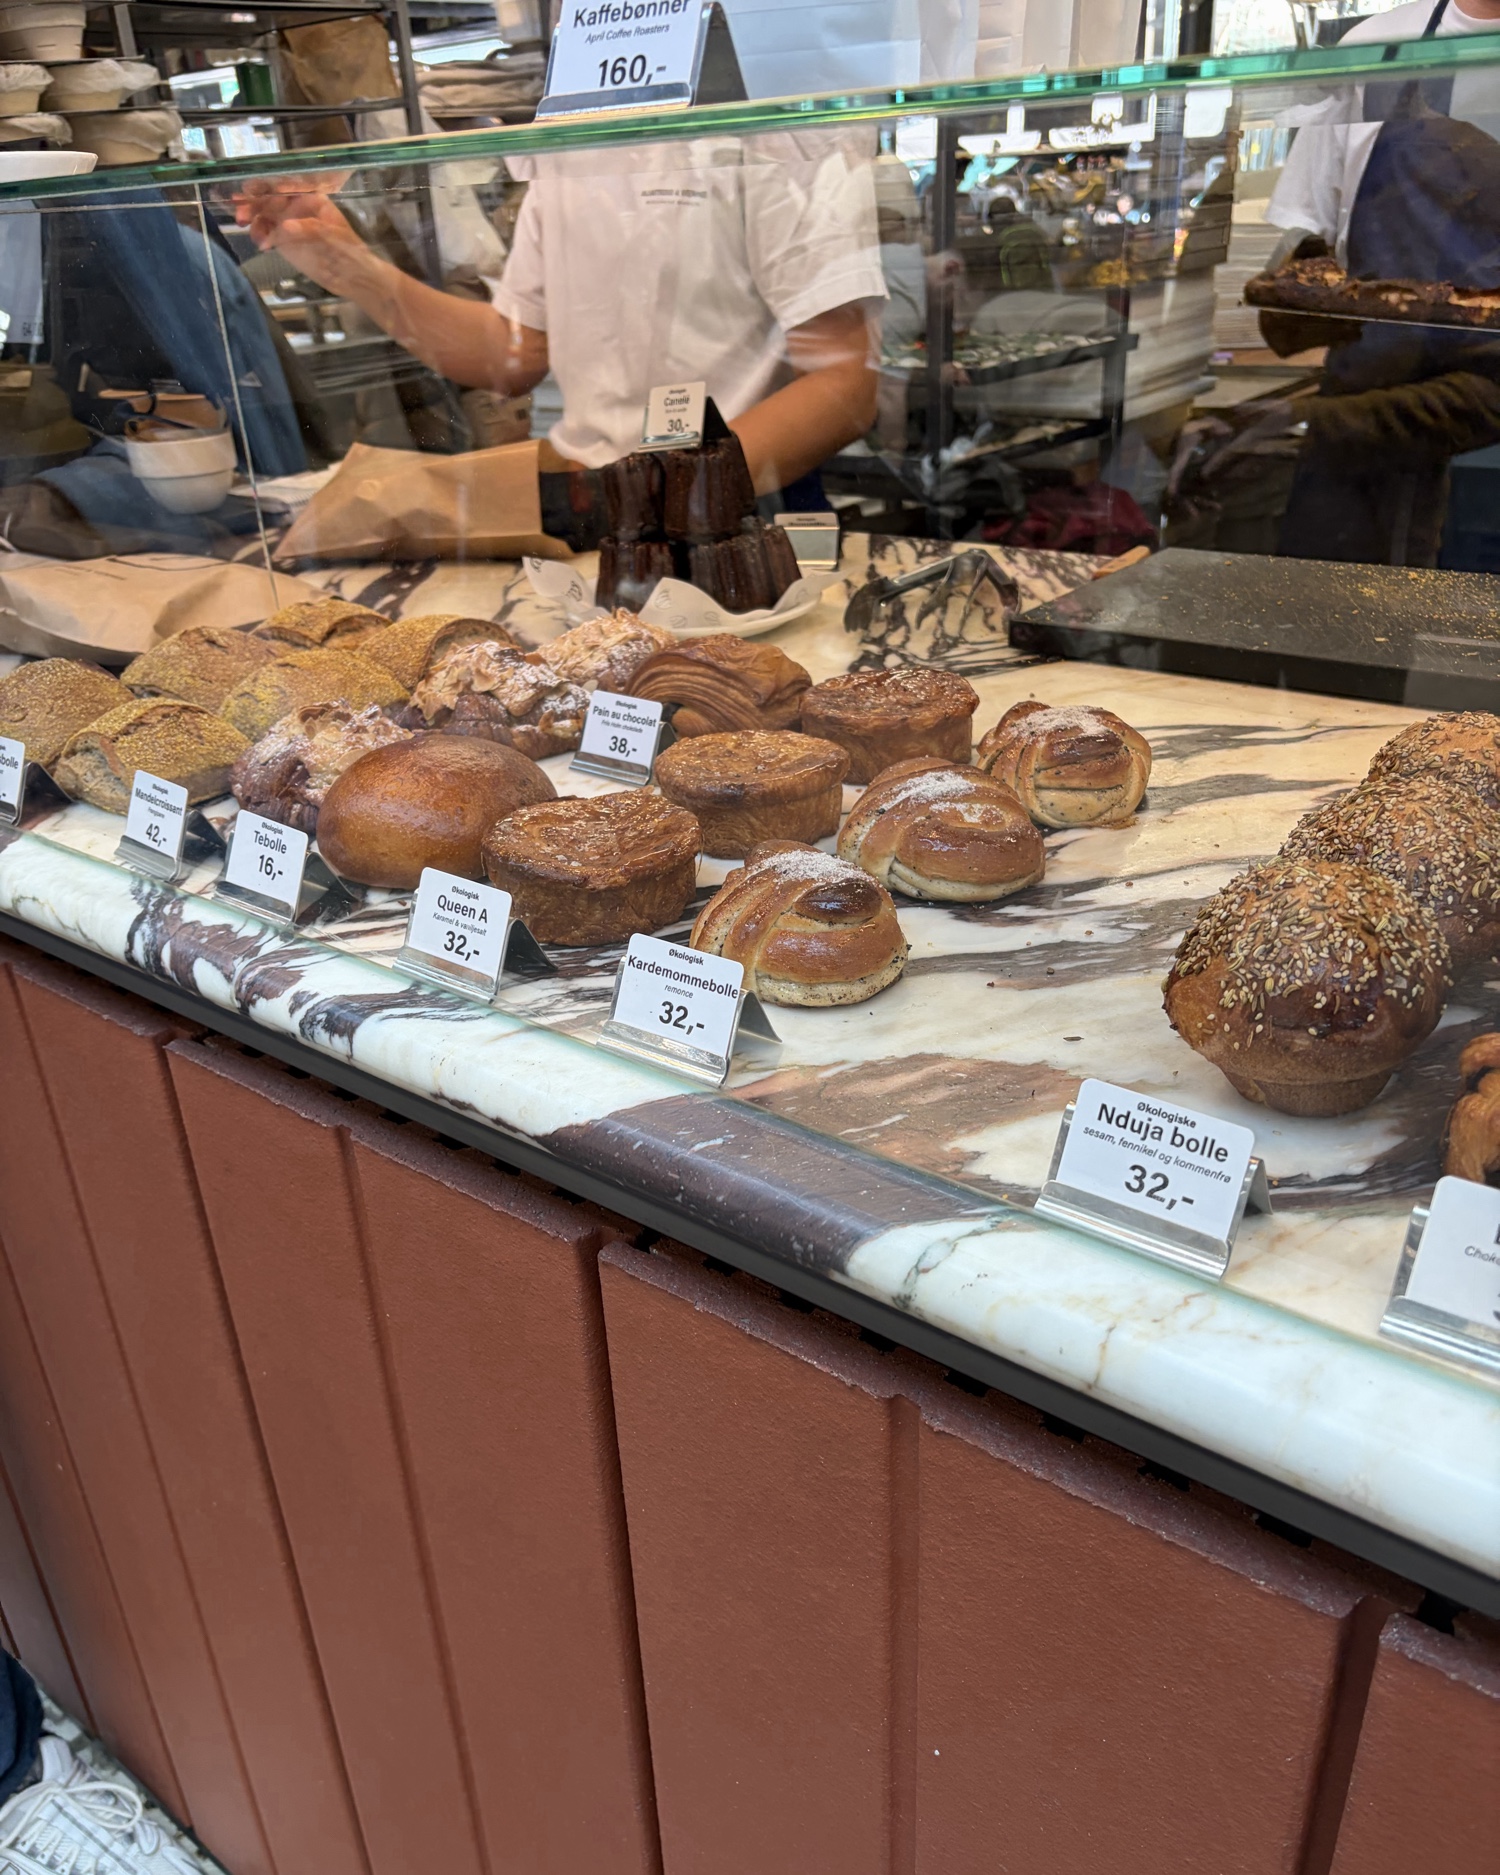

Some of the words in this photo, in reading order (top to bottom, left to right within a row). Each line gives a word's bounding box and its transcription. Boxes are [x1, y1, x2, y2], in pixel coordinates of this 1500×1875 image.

[573, 0, 690, 29] Kaffebønner
[584, 29, 605, 45] April
[605, 27, 632, 41] Coffee
[633, 23, 670, 38] Roasters
[598, 54, 667, 88] 160,-
[592, 705, 610, 718] Pain
[611, 710, 621, 720] au
[622, 712, 657, 728] chocolat
[608, 735, 638, 758] 38,-
[0, 753, 19, 770] bolle
[135, 787, 183, 816] Mandelcroissant
[145, 822, 168, 848] 42,-
[253, 830, 287, 854] Tebolle
[261, 821, 284, 836] Økologisk
[258, 854, 284, 881] 16,-
[451, 885, 480, 901] Økologisk
[437, 894, 476, 920] Queen
[478, 908, 488, 924] A
[432, 911, 455, 926] Karamel
[454, 918, 461, 928] &
[460, 922, 487, 937] vaniljesalt
[443, 930, 480, 961] 32,-
[668, 948, 704, 966] Økologisk
[627, 954, 738, 999] Kardemommebolle
[664, 984, 694, 999] remonce
[658, 1000, 705, 1036] 32,-
[1137, 1101, 1197, 1129] Økologiske
[1097, 1102, 1164, 1142] Nduja
[1169, 1126, 1229, 1163] bolle
[1082, 1125, 1117, 1145] sesam,
[1118, 1136, 1158, 1159] fennikel
[1158, 1152, 1173, 1165] og
[1173, 1155, 1232, 1184] kommenfrø
[1124, 1163, 1195, 1211] 32,-
